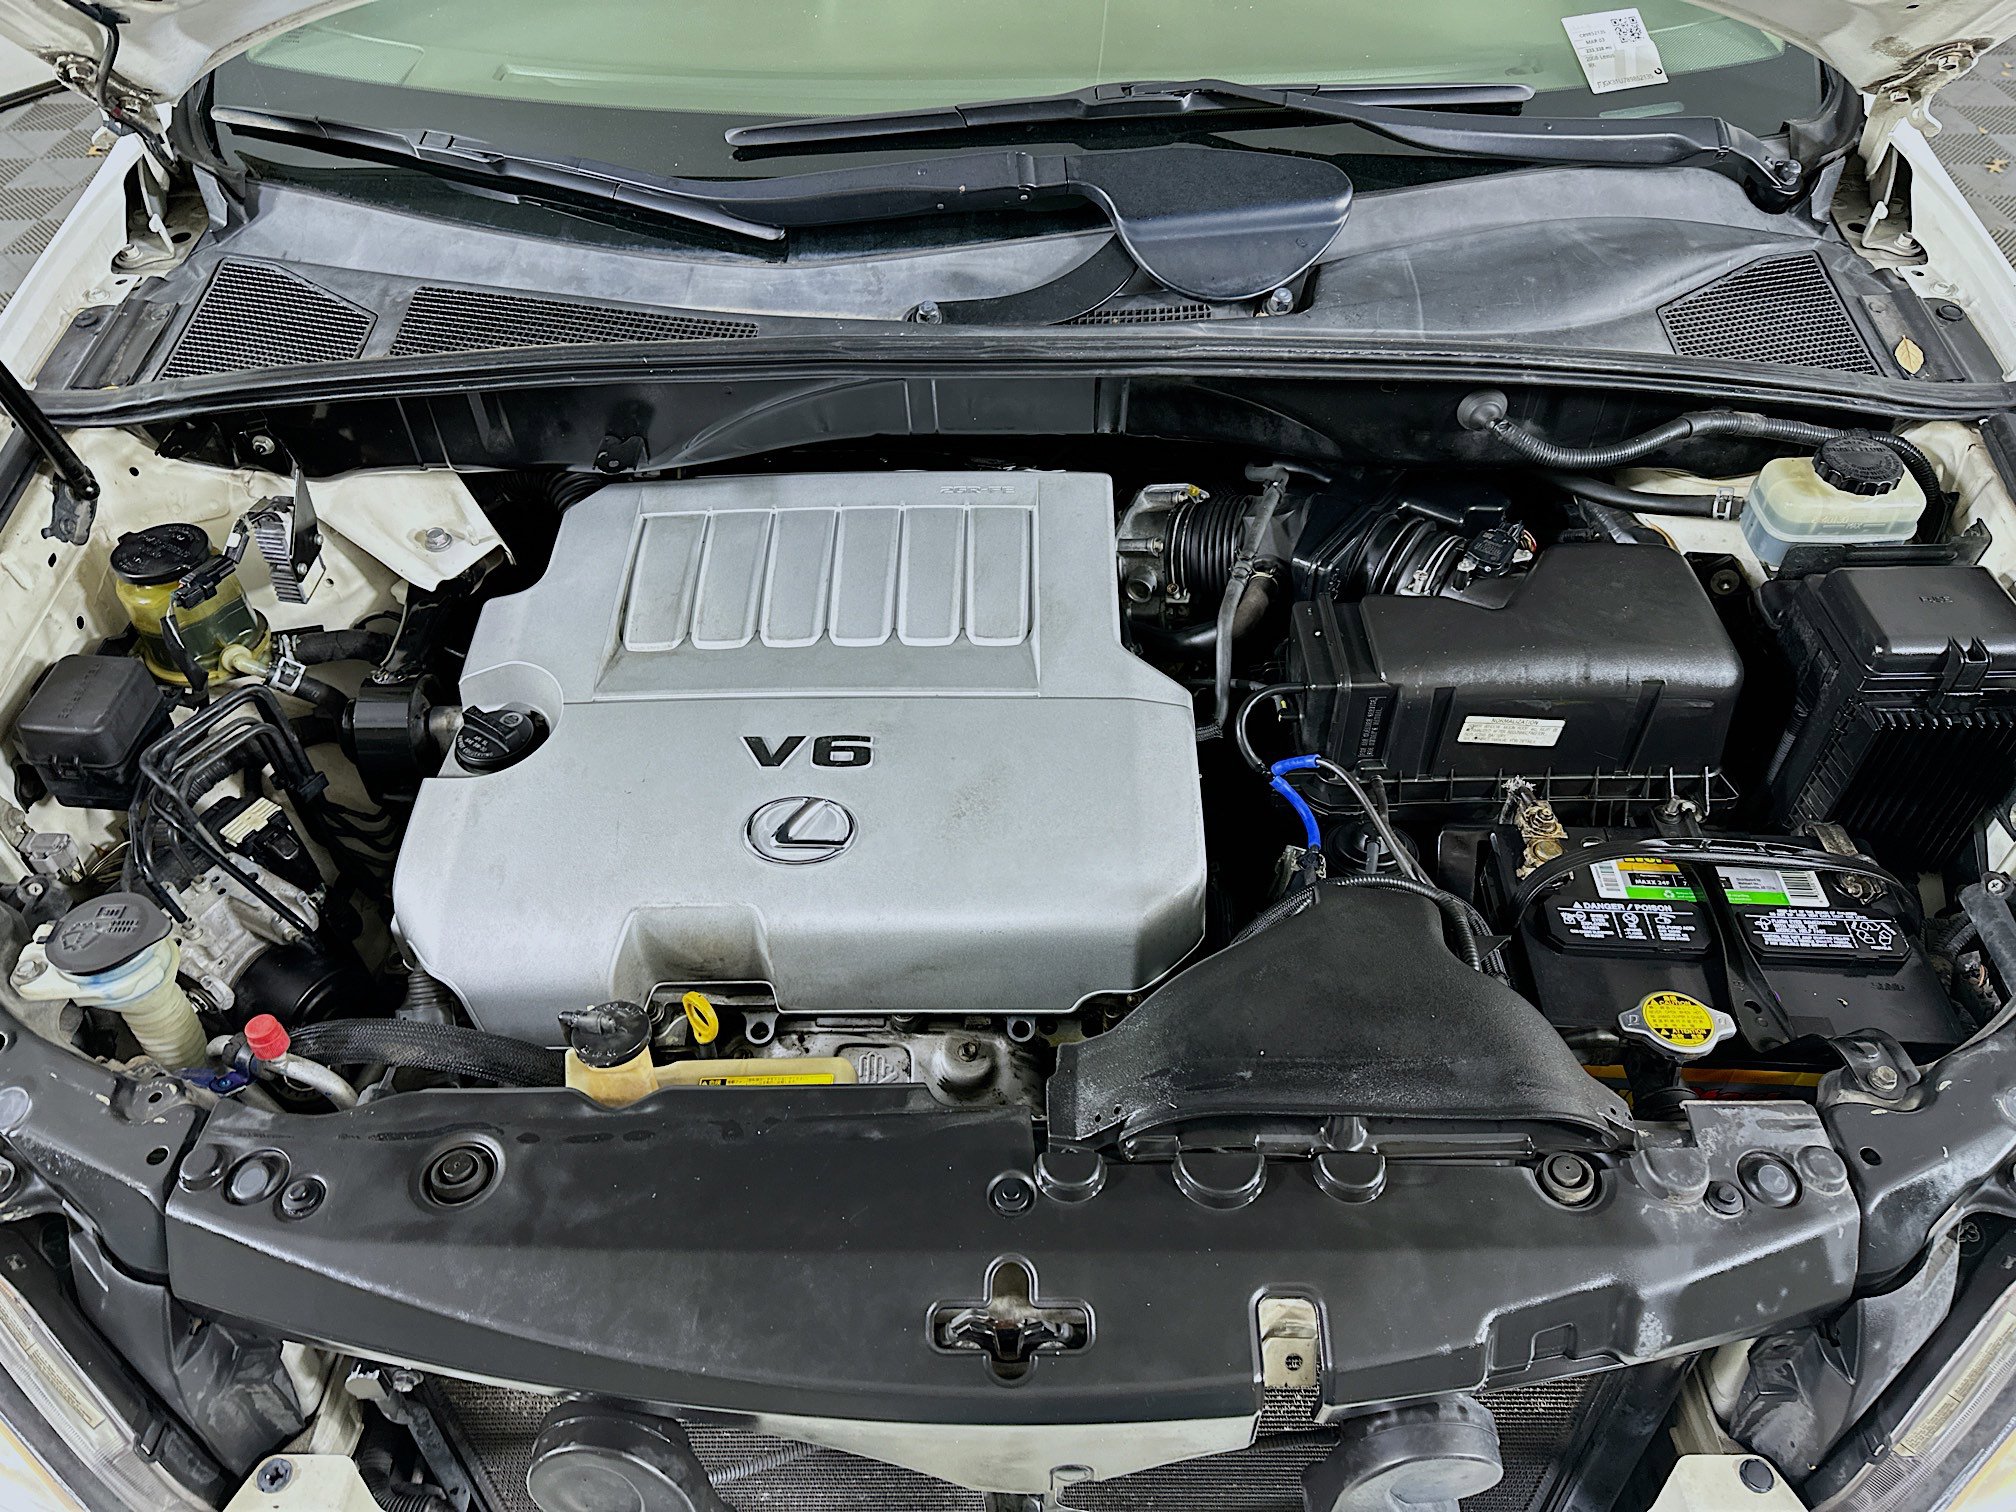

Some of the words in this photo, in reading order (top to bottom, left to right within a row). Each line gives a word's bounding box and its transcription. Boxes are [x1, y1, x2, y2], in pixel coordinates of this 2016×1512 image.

[739, 734, 875, 770] V6
[1634, 878, 1656, 886] MAXX
[1583, 902, 1625, 910] DANGER
[1634, 904, 1672, 912] POISON
